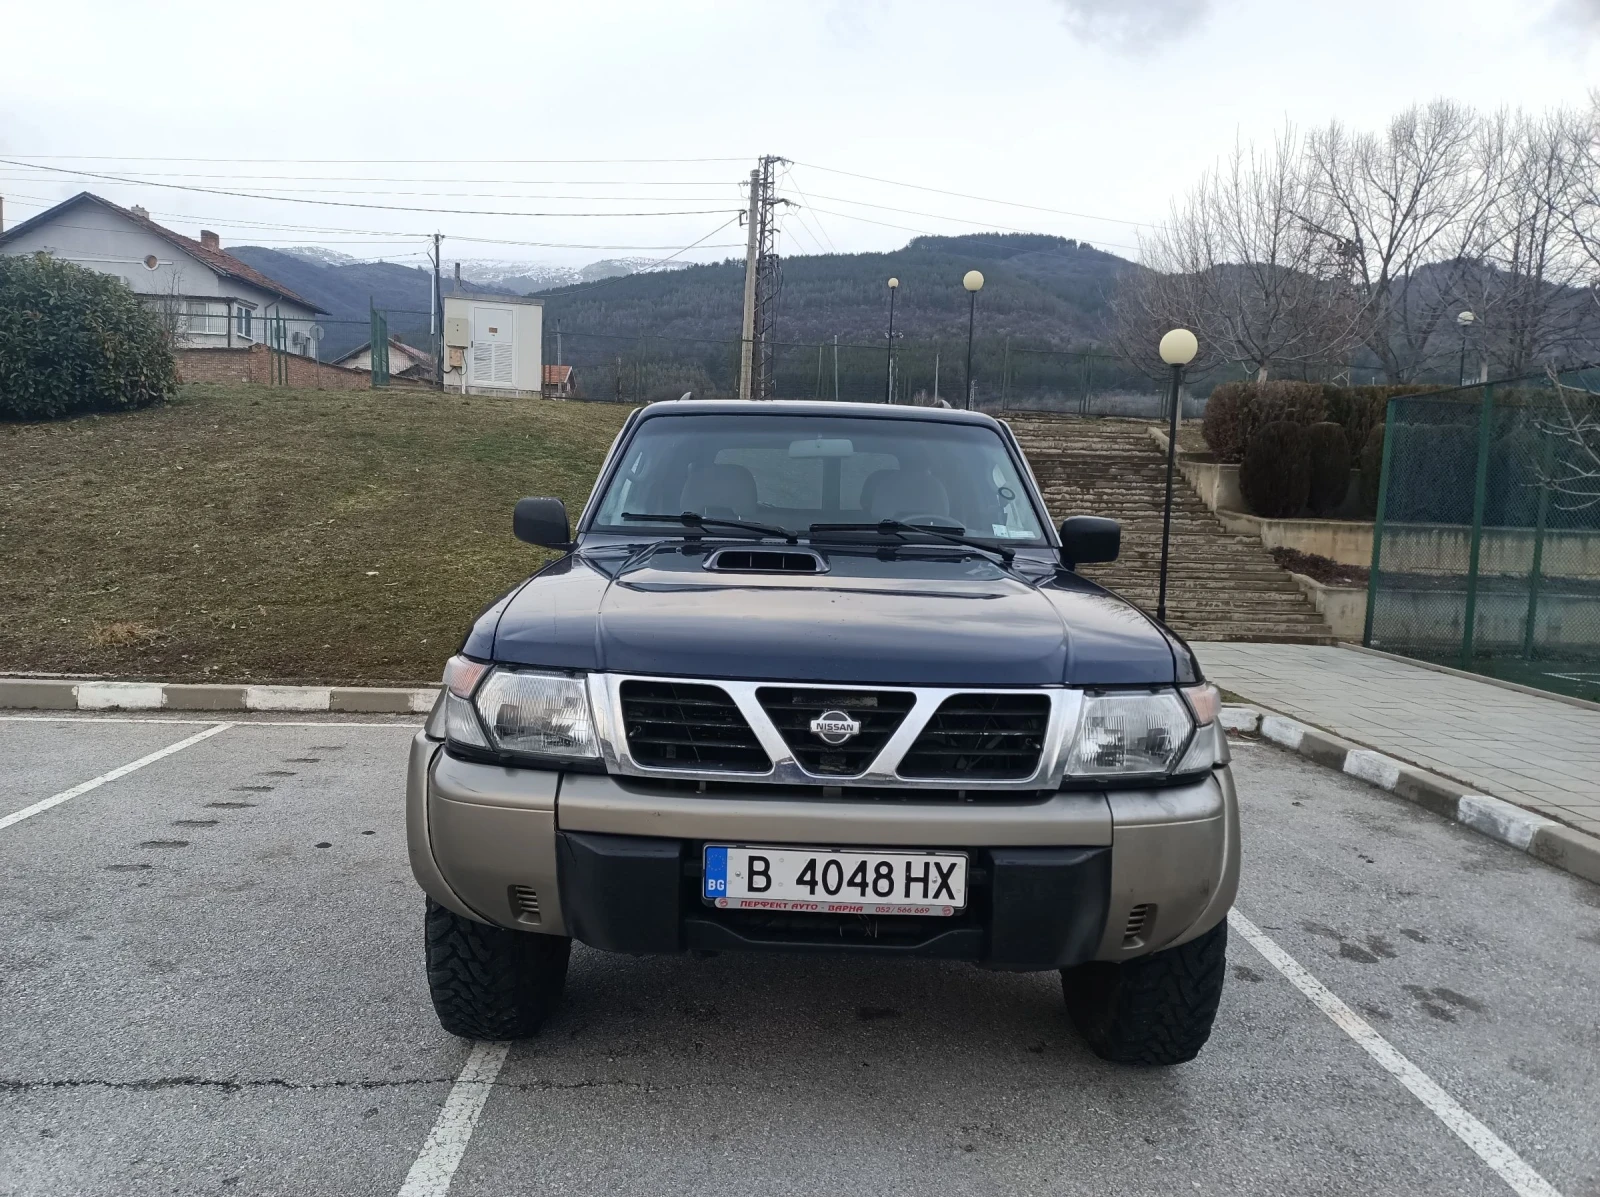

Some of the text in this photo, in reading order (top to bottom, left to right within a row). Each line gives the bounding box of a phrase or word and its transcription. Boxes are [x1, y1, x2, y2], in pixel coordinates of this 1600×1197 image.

[816, 722, 854, 731] NISSAN
[708, 879, 725, 891] BG
[740, 900, 788, 909] ПЕРФЕКТ
[828, 904, 864, 913] ВАРНА
